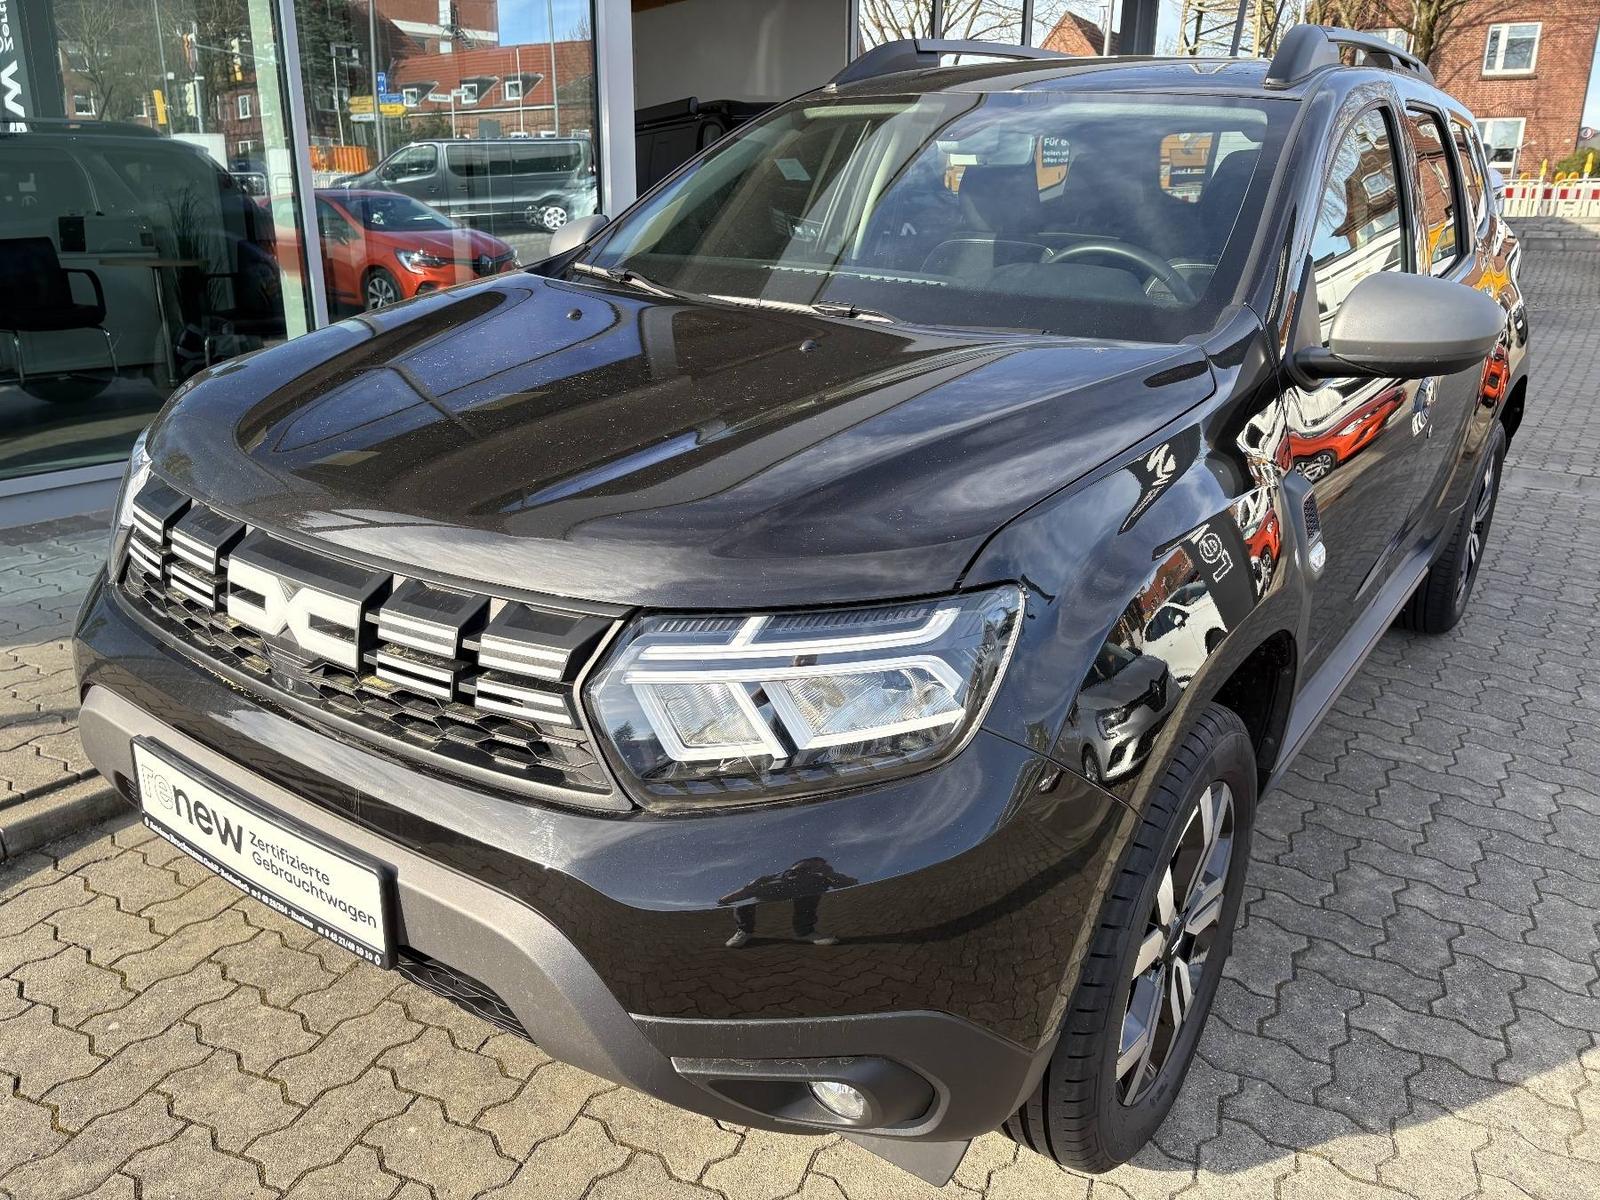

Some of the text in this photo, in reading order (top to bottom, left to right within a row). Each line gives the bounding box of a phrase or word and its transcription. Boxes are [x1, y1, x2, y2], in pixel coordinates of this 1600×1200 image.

[142, 764, 243, 855] renew
[249, 831, 330, 886] Zertifizierte
[252, 851, 377, 929] Gebrauchtwagen
